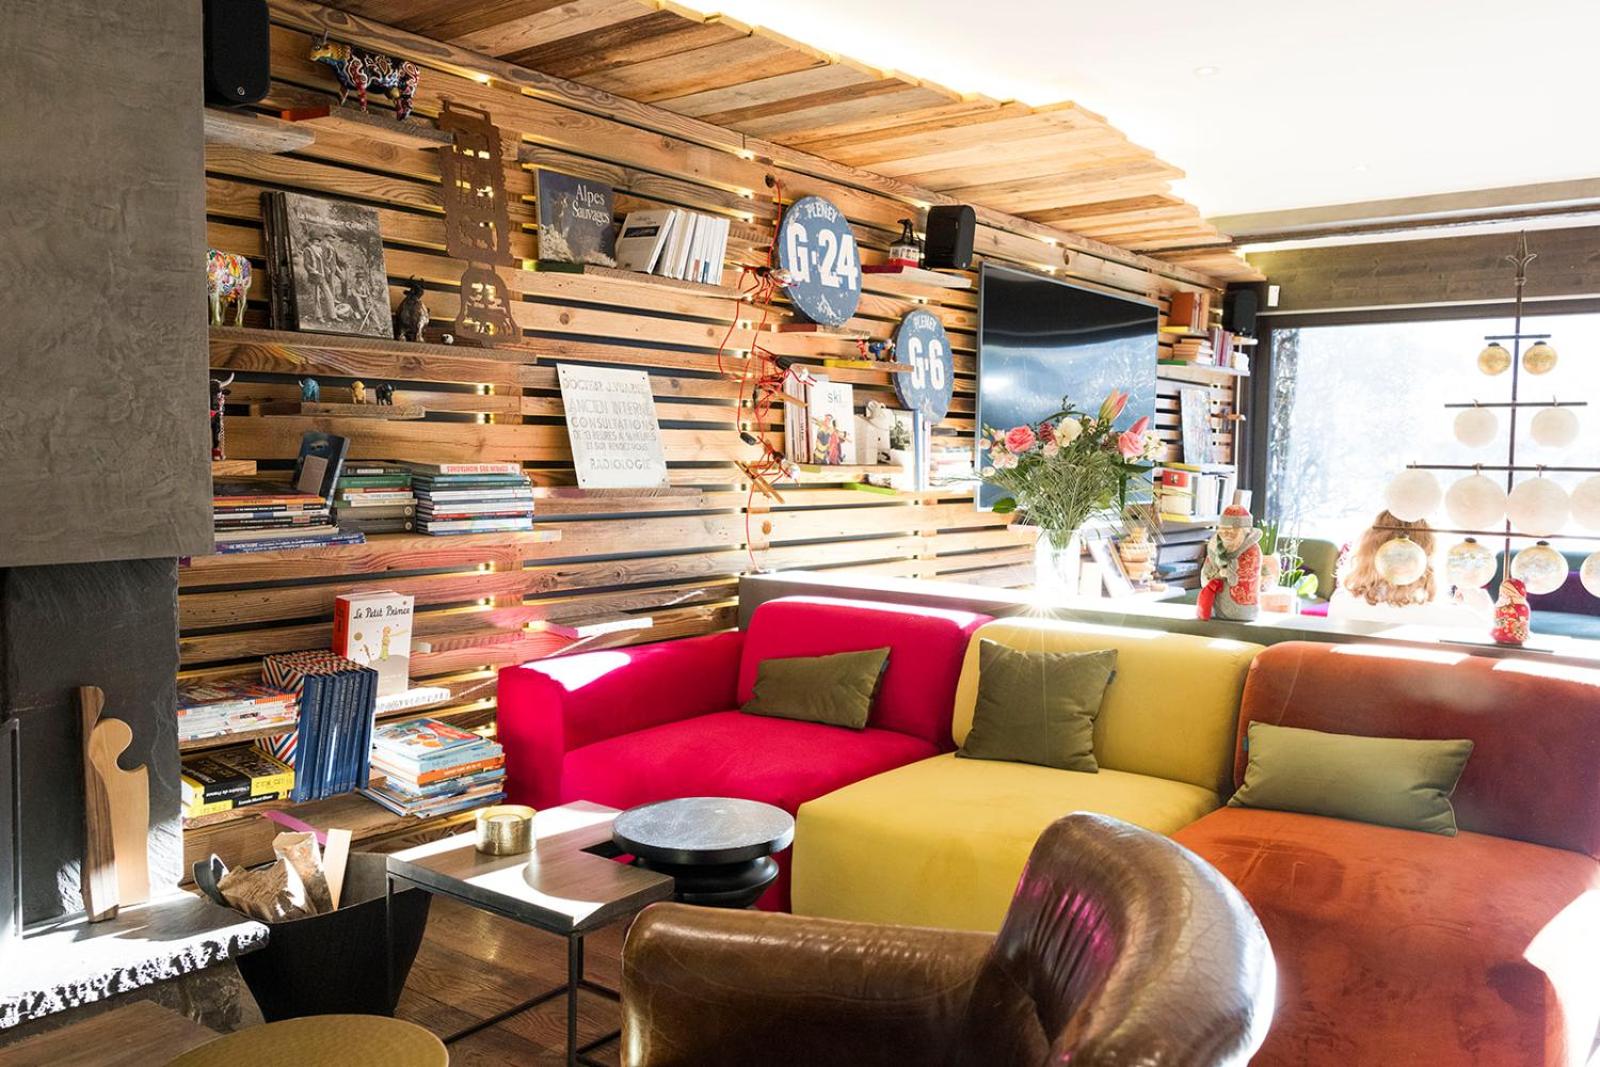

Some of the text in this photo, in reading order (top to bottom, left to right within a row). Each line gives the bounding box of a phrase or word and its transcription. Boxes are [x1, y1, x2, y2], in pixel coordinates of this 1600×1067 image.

[576, 184, 605, 207] Alpes
[572, 202, 610, 226] Sauvages
[571, 416, 656, 432] CONSULTATIONS
[590, 458, 651, 471] RADIOLOGIE
[352, 607, 364, 620] Le
[365, 606, 383, 619] Petit
[386, 605, 411, 617] Prince
